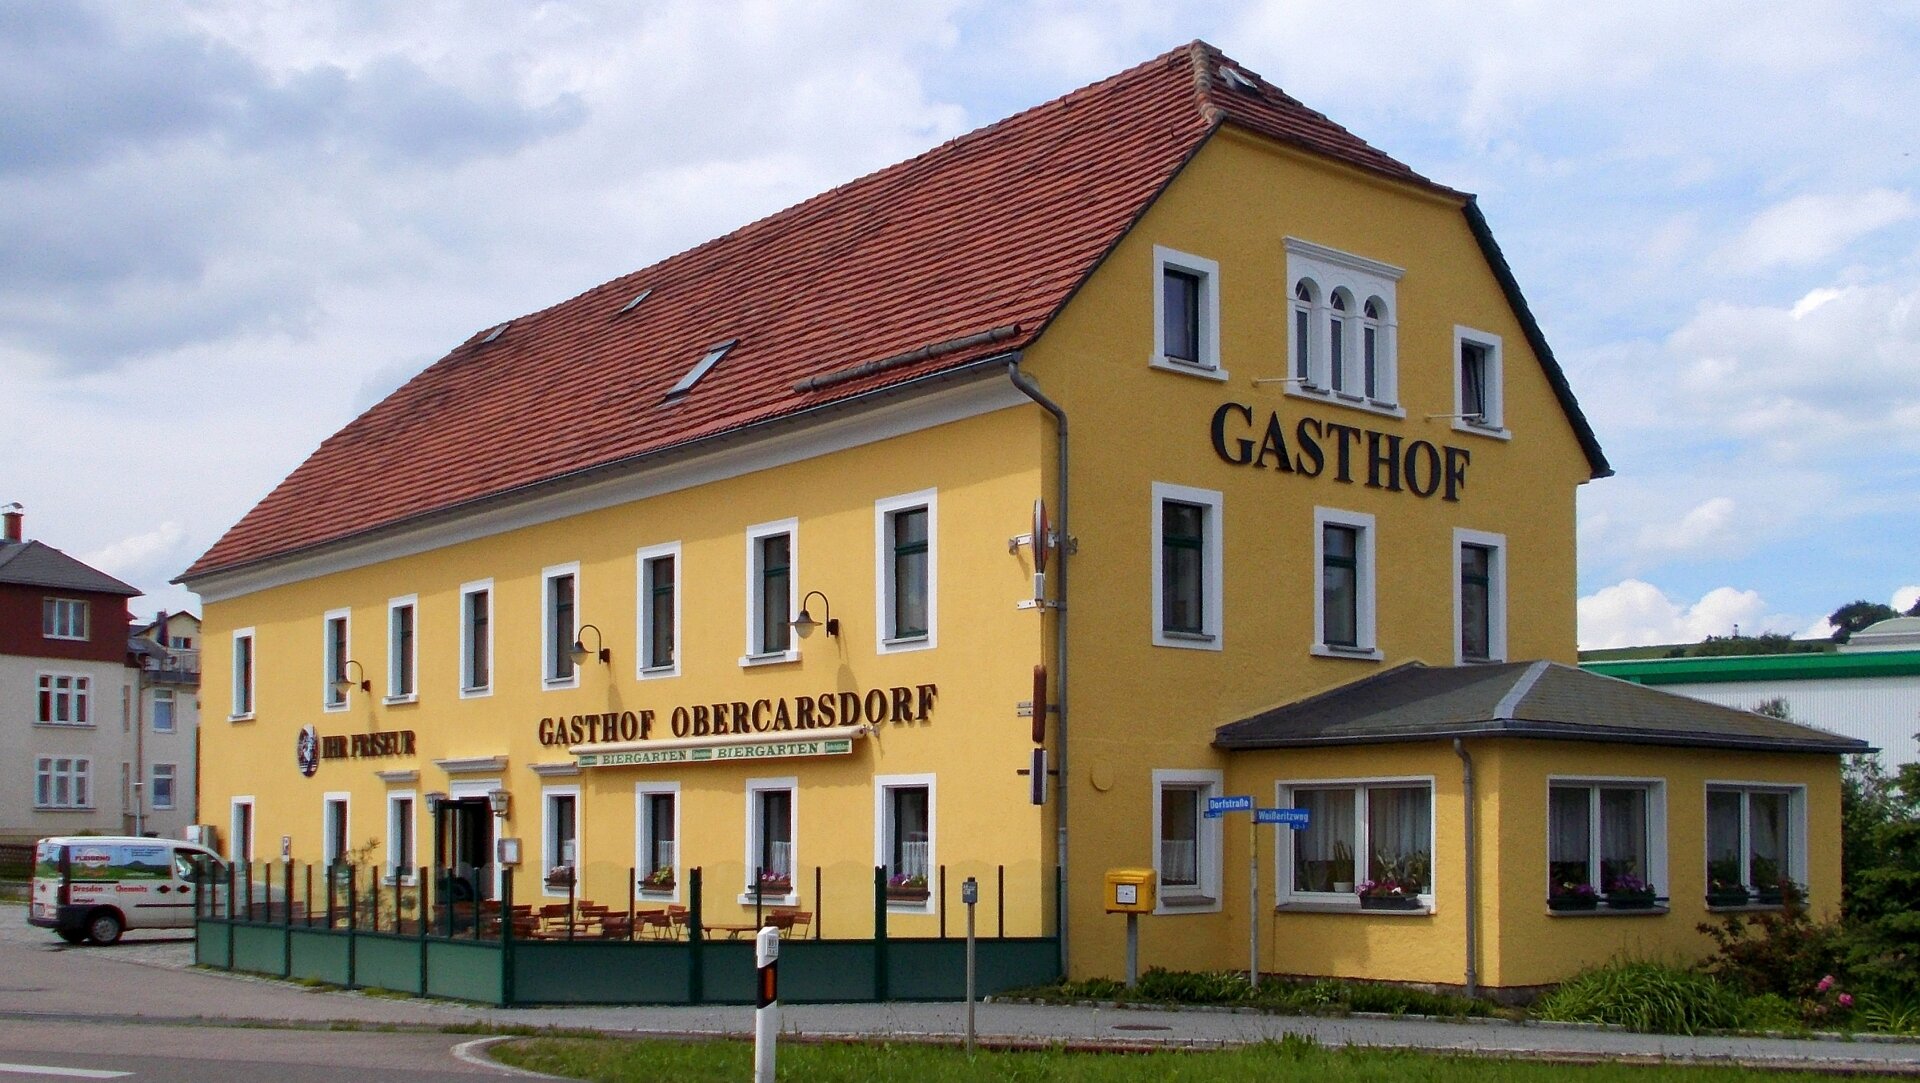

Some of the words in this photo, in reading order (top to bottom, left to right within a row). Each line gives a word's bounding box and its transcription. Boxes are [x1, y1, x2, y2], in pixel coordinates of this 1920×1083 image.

[1211, 402, 1470, 503] GASTHOF
[539, 710, 654, 745] GASTHOF
[671, 684, 936, 738] OBERCARSDORF
[322, 735, 348, 758] IHR
[351, 730, 416, 757] FRISEUR
[603, 750, 687, 764] BIERGARTEN
[717, 742, 819, 758] BIERGARTEN
[1210, 798, 1249, 809] Dorfstraße
[1258, 810, 1309, 822] Weißeritzweg
[73, 885, 103, 893] Dresden
[115, 884, 148, 893] Chemnitz
